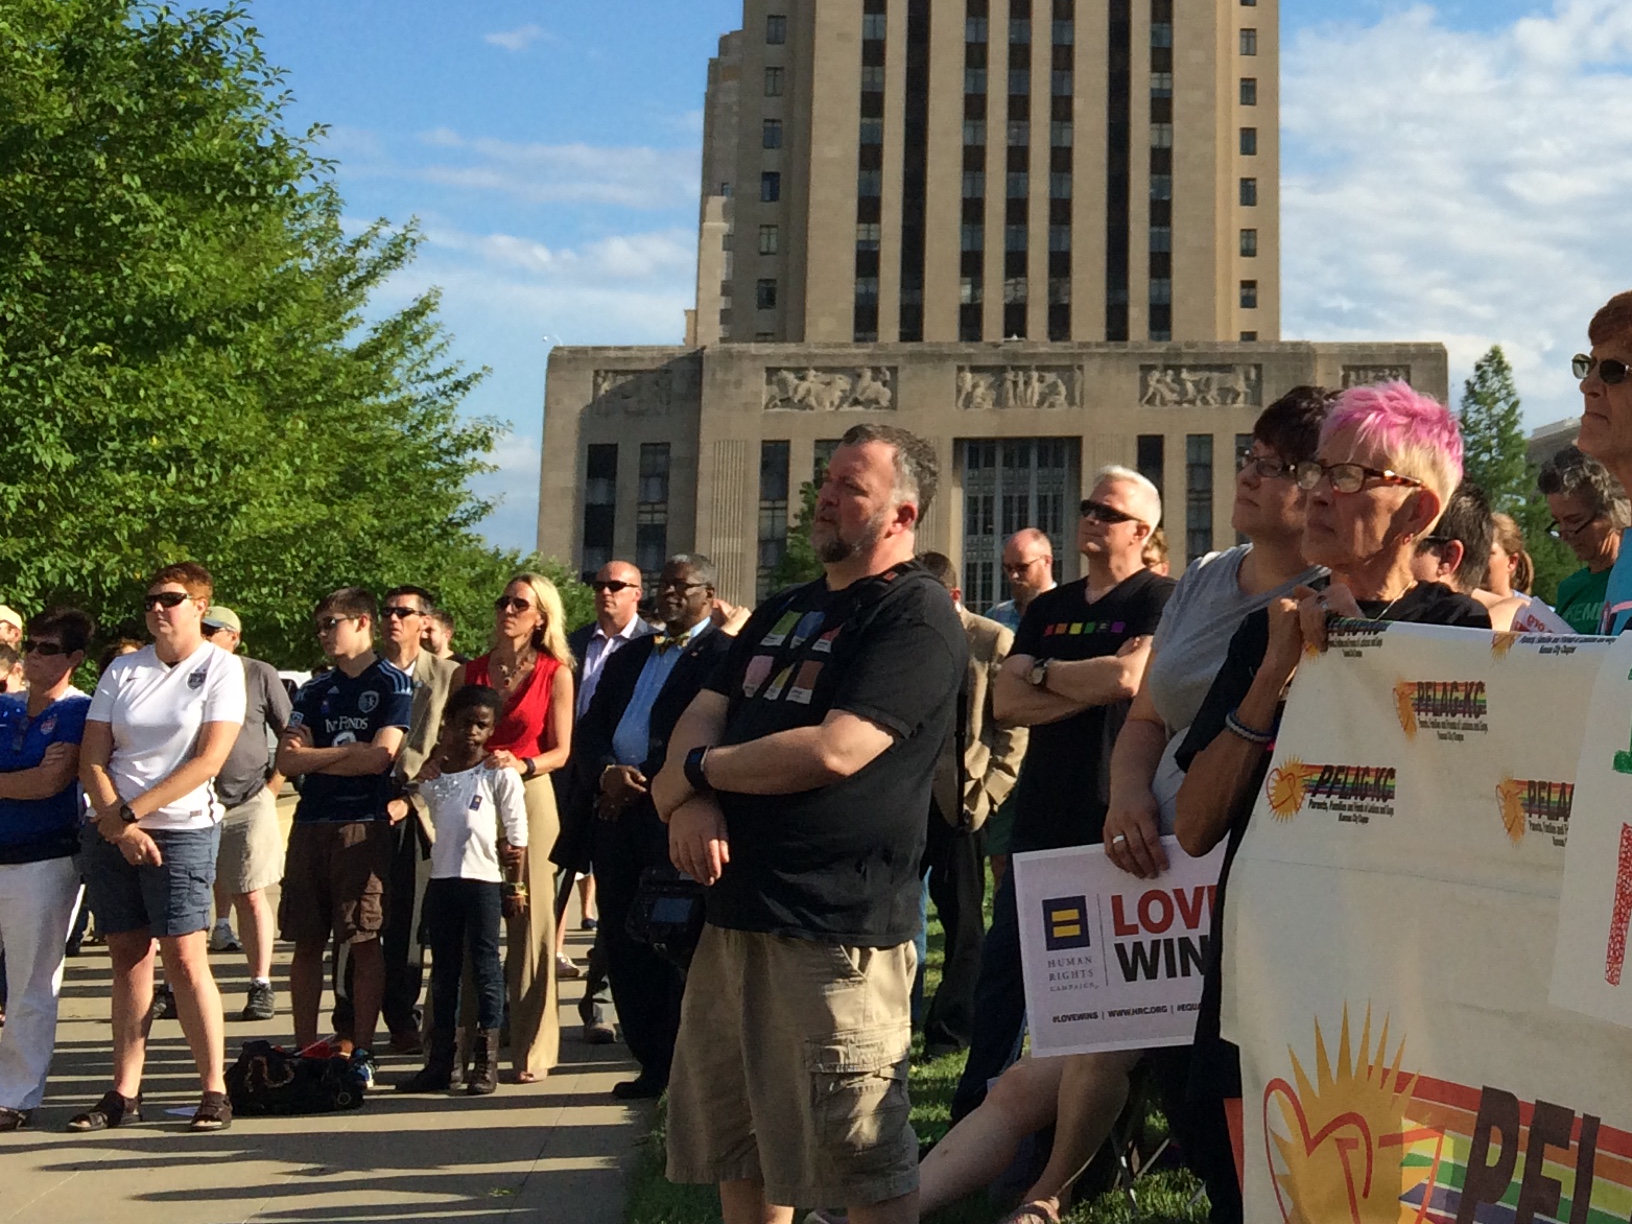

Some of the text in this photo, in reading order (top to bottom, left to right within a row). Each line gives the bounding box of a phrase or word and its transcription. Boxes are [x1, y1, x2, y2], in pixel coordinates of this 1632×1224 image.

[1111, 885, 1217, 937] LOV
[1047, 956, 1092, 968] HUMAN
[1049, 969, 1094, 982] RIGHTS
